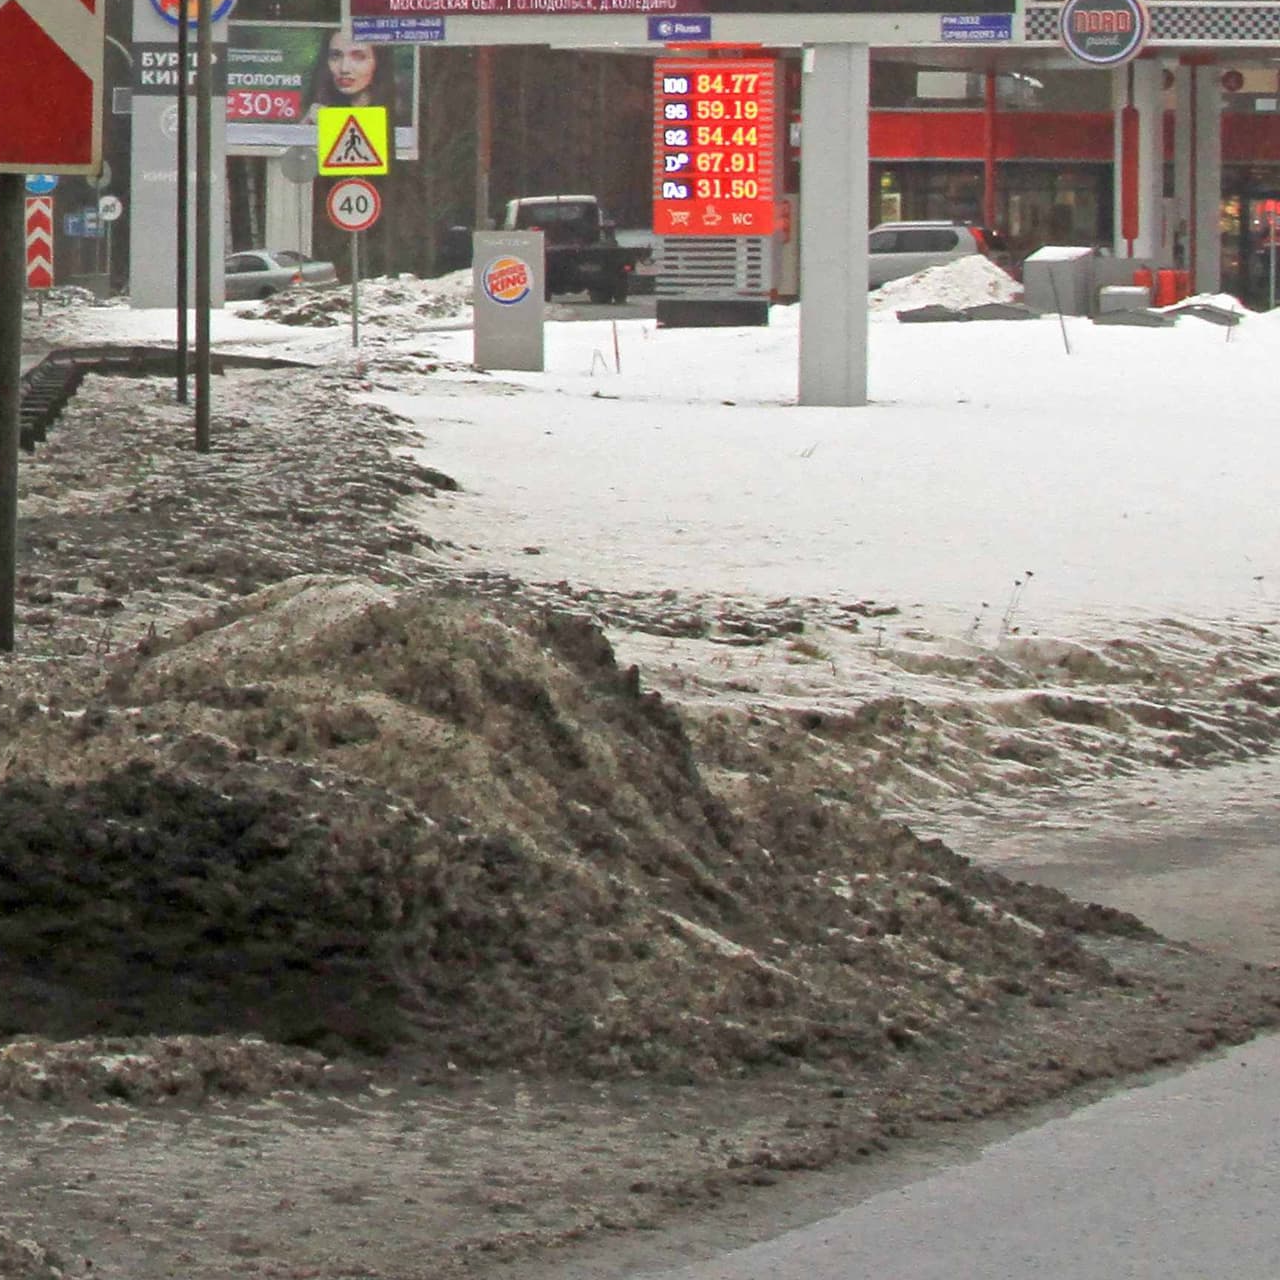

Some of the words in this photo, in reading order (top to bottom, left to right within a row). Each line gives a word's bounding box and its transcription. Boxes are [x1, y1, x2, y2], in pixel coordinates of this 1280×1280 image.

[142, 52, 218, 67] БУР
[664, 78, 688, 94] 100
[696, 74, 759, 94] 84.77
[665, 104, 688, 119] 95
[696, 100, 759, 120] 59.19
[665, 129, 688, 145] 92
[696, 126, 758, 146] 54.44
[696, 152, 756, 172] 67.91
[696, 178, 758, 198] 31.50
[339, 194, 368, 215] 40
[731, 212, 753, 226] WC
[490, 271, 527, 296] KING
